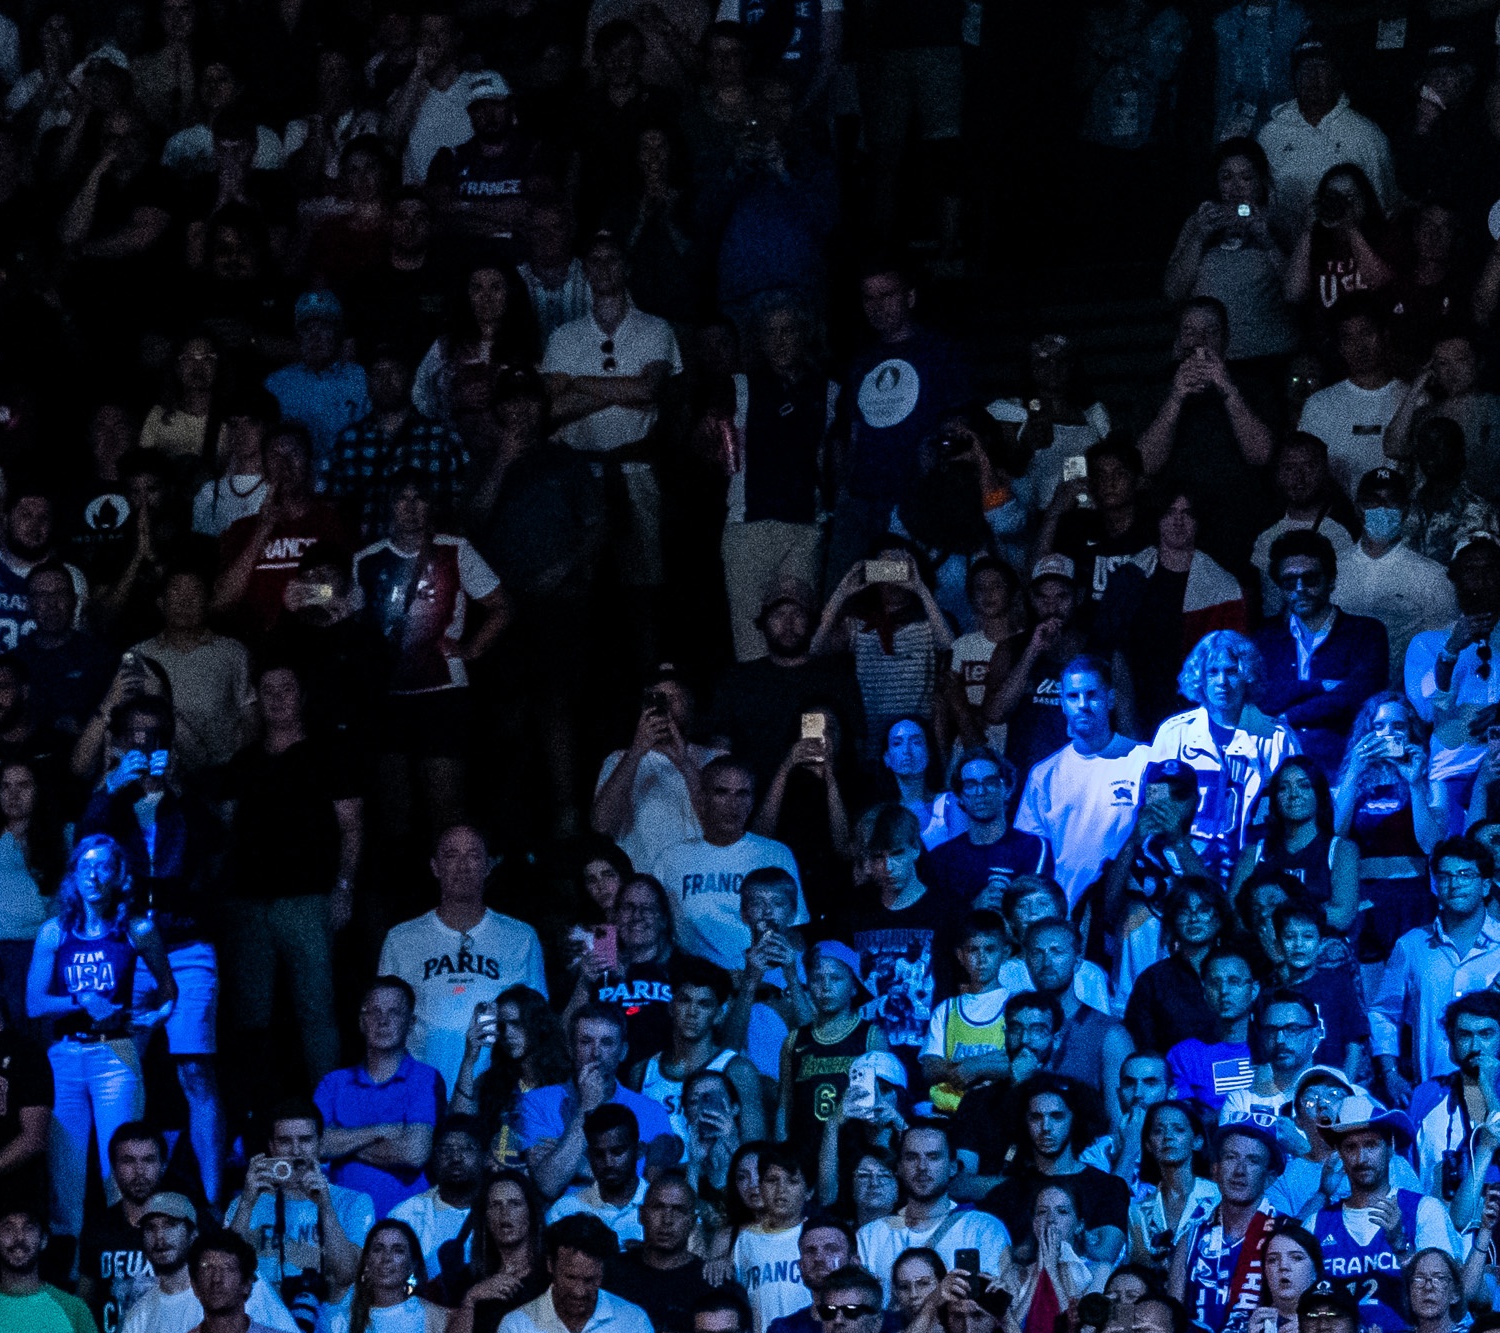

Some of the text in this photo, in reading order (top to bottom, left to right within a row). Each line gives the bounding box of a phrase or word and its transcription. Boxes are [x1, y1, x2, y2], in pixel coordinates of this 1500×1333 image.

[681, 872, 742, 900] FRANC
[73, 951, 104, 962] TEAM
[422, 954, 500, 983] PARIS
[64, 962, 113, 993] USA
[596, 981, 671, 1005] PARIS
